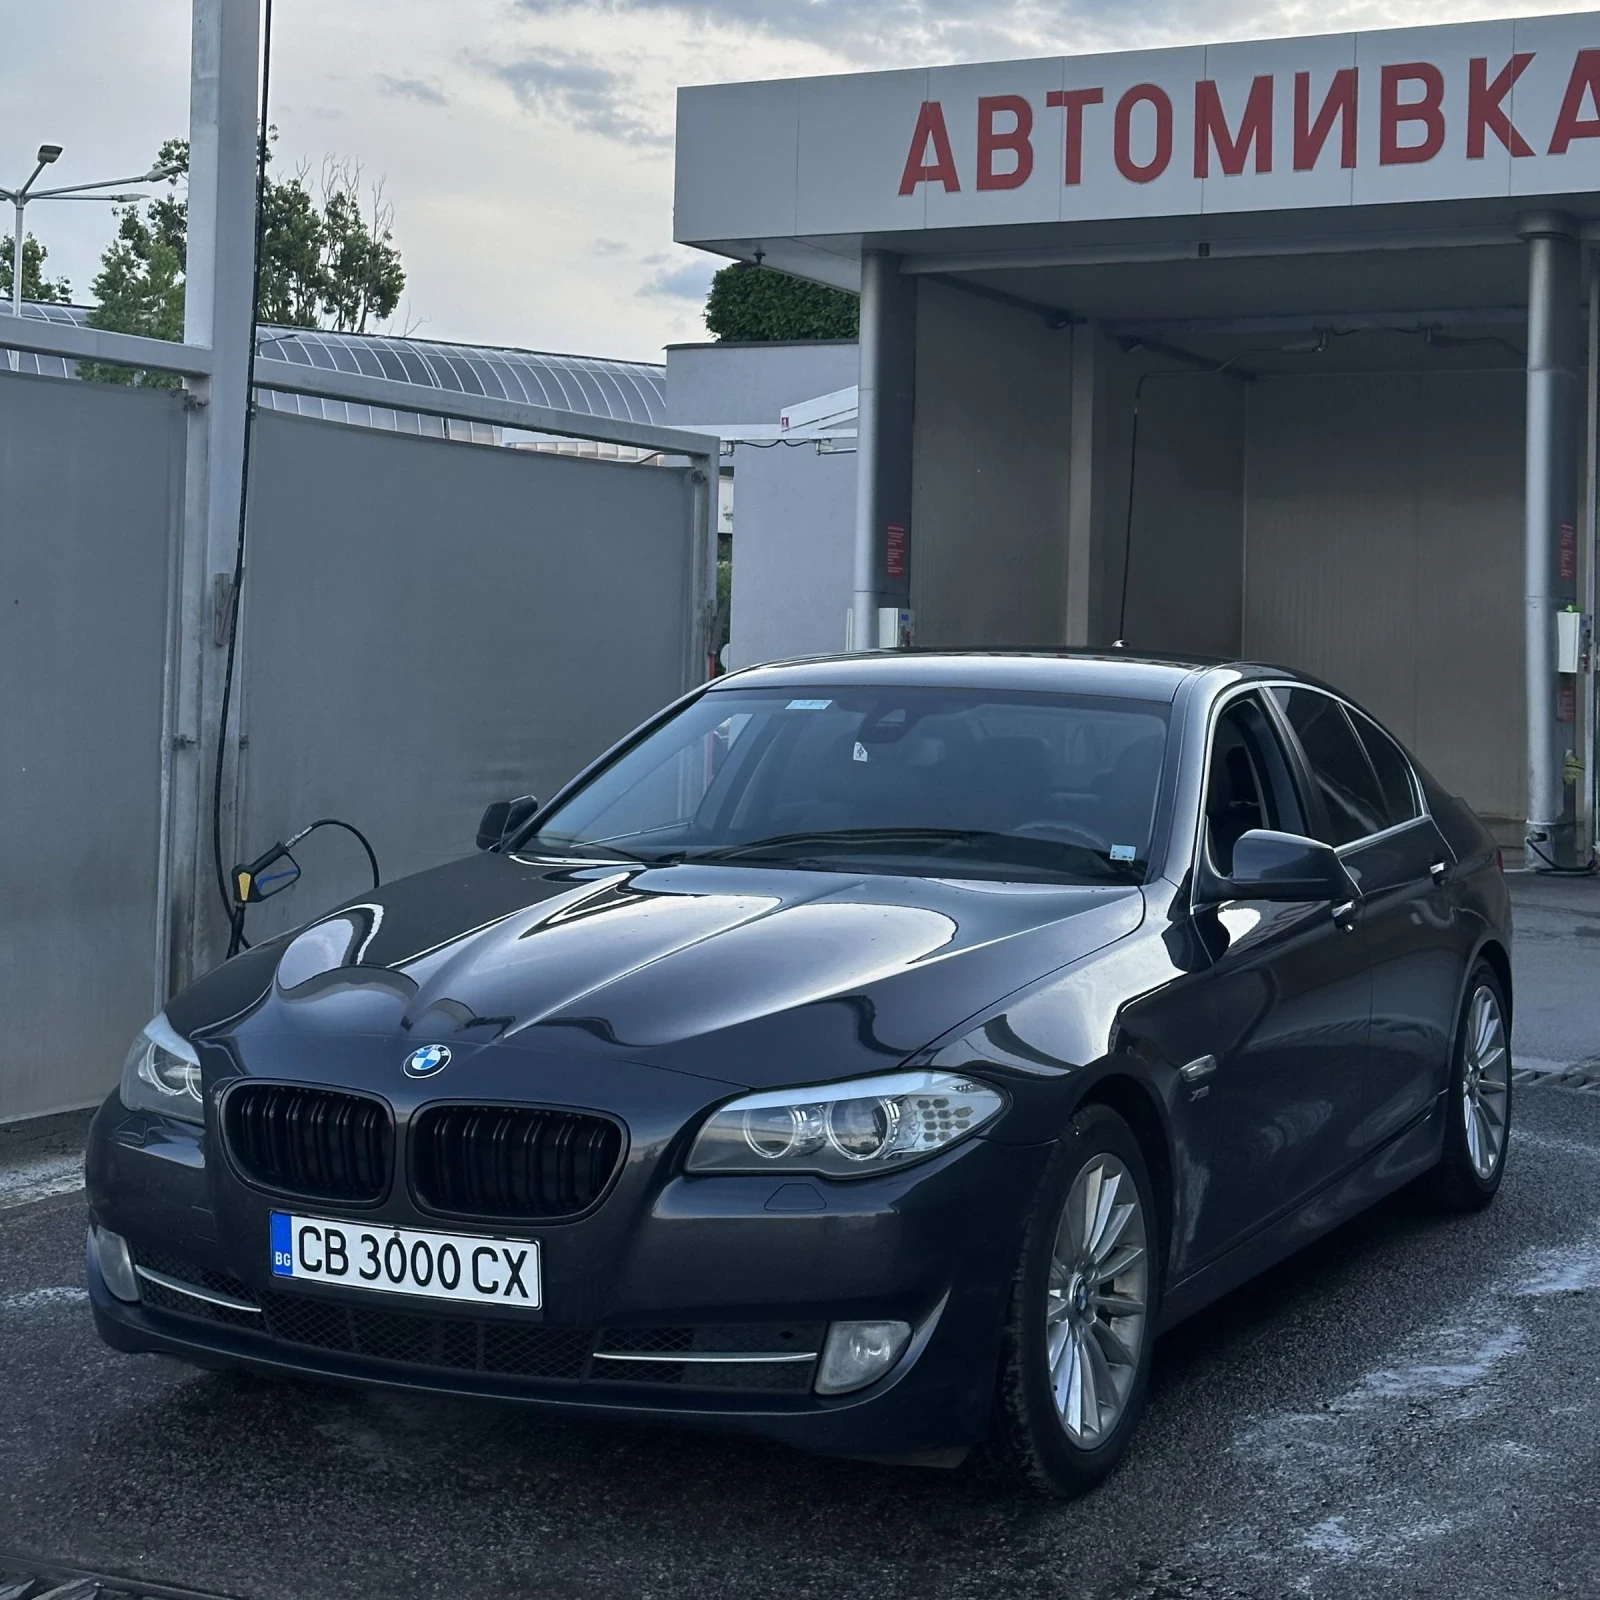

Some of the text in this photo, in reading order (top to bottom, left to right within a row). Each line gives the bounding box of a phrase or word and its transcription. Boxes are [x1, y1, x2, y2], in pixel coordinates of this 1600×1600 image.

[897, 49, 1600, 196] АВТОМИВКА
[275, 1252, 291, 1266] BG
[299, 1225, 529, 1298] CB 3000 CX
